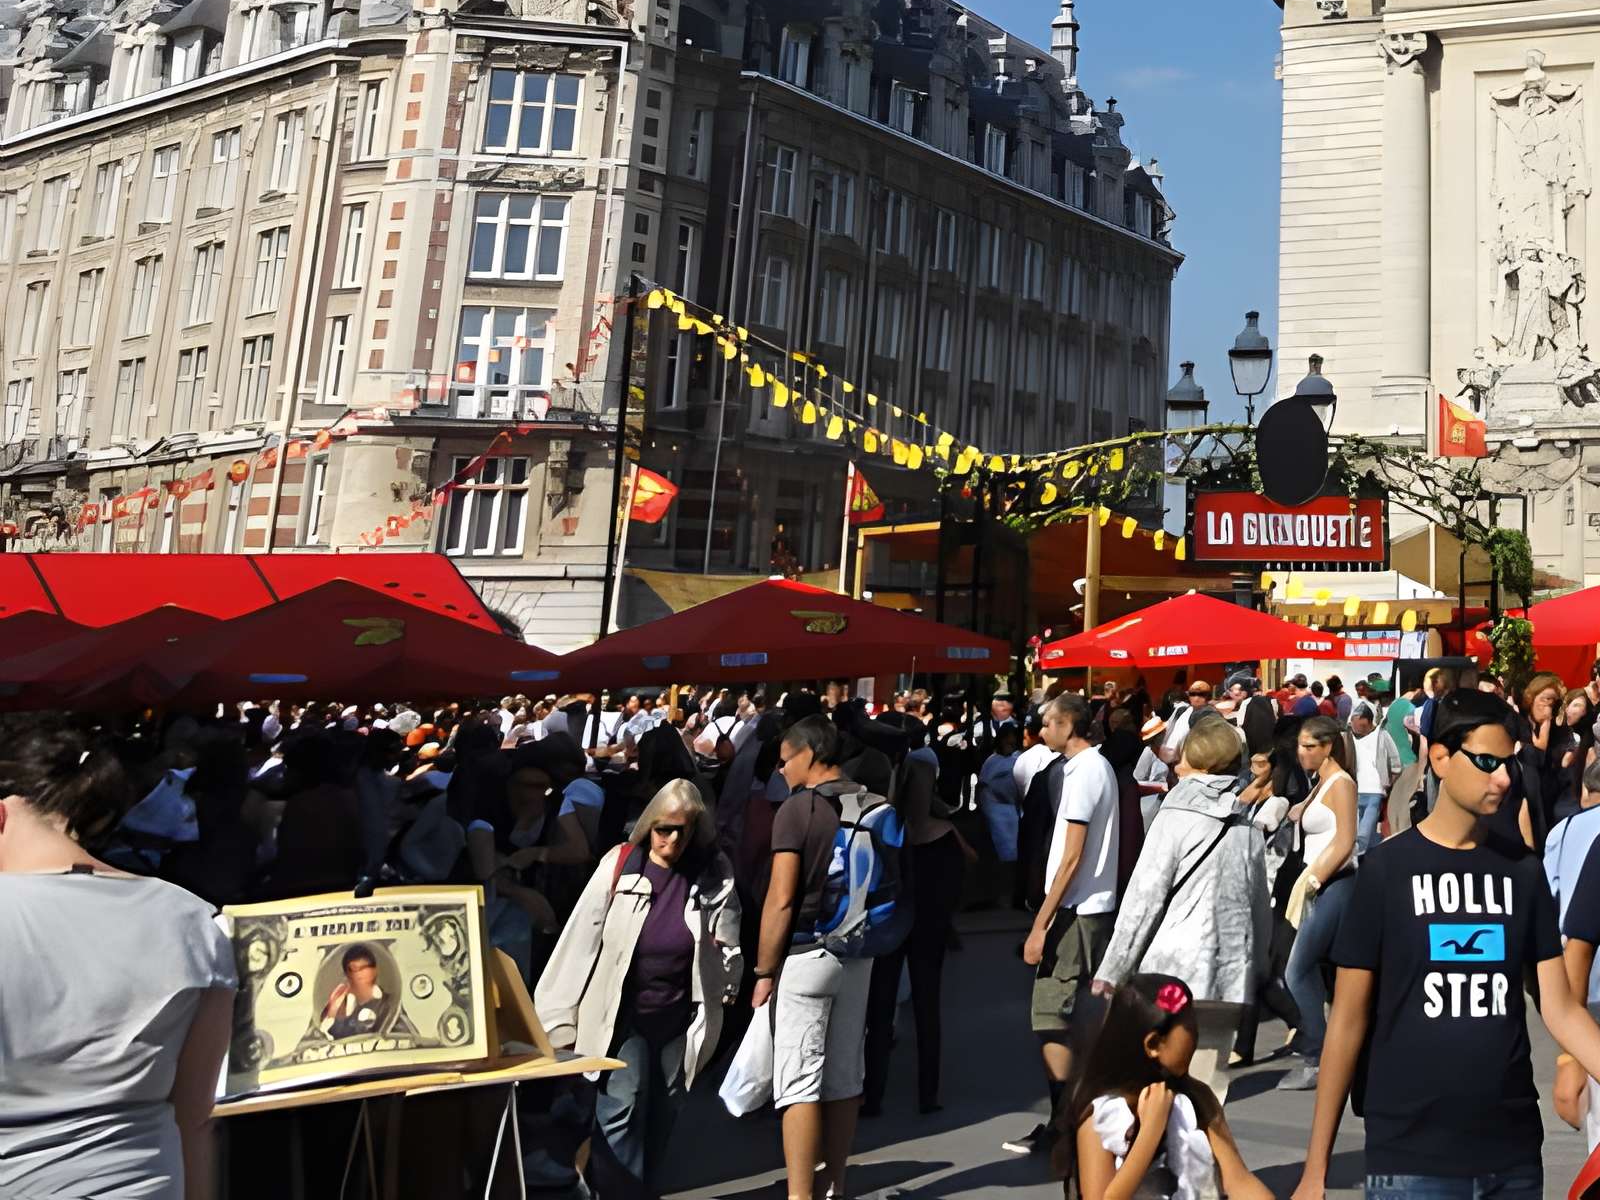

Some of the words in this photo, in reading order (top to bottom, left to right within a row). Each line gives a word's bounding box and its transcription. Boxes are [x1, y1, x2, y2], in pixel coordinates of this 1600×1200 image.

[1206, 510, 1234, 545] LA
[1411, 872, 1513, 917] HOLLI
[1423, 971, 1509, 1018] STER
